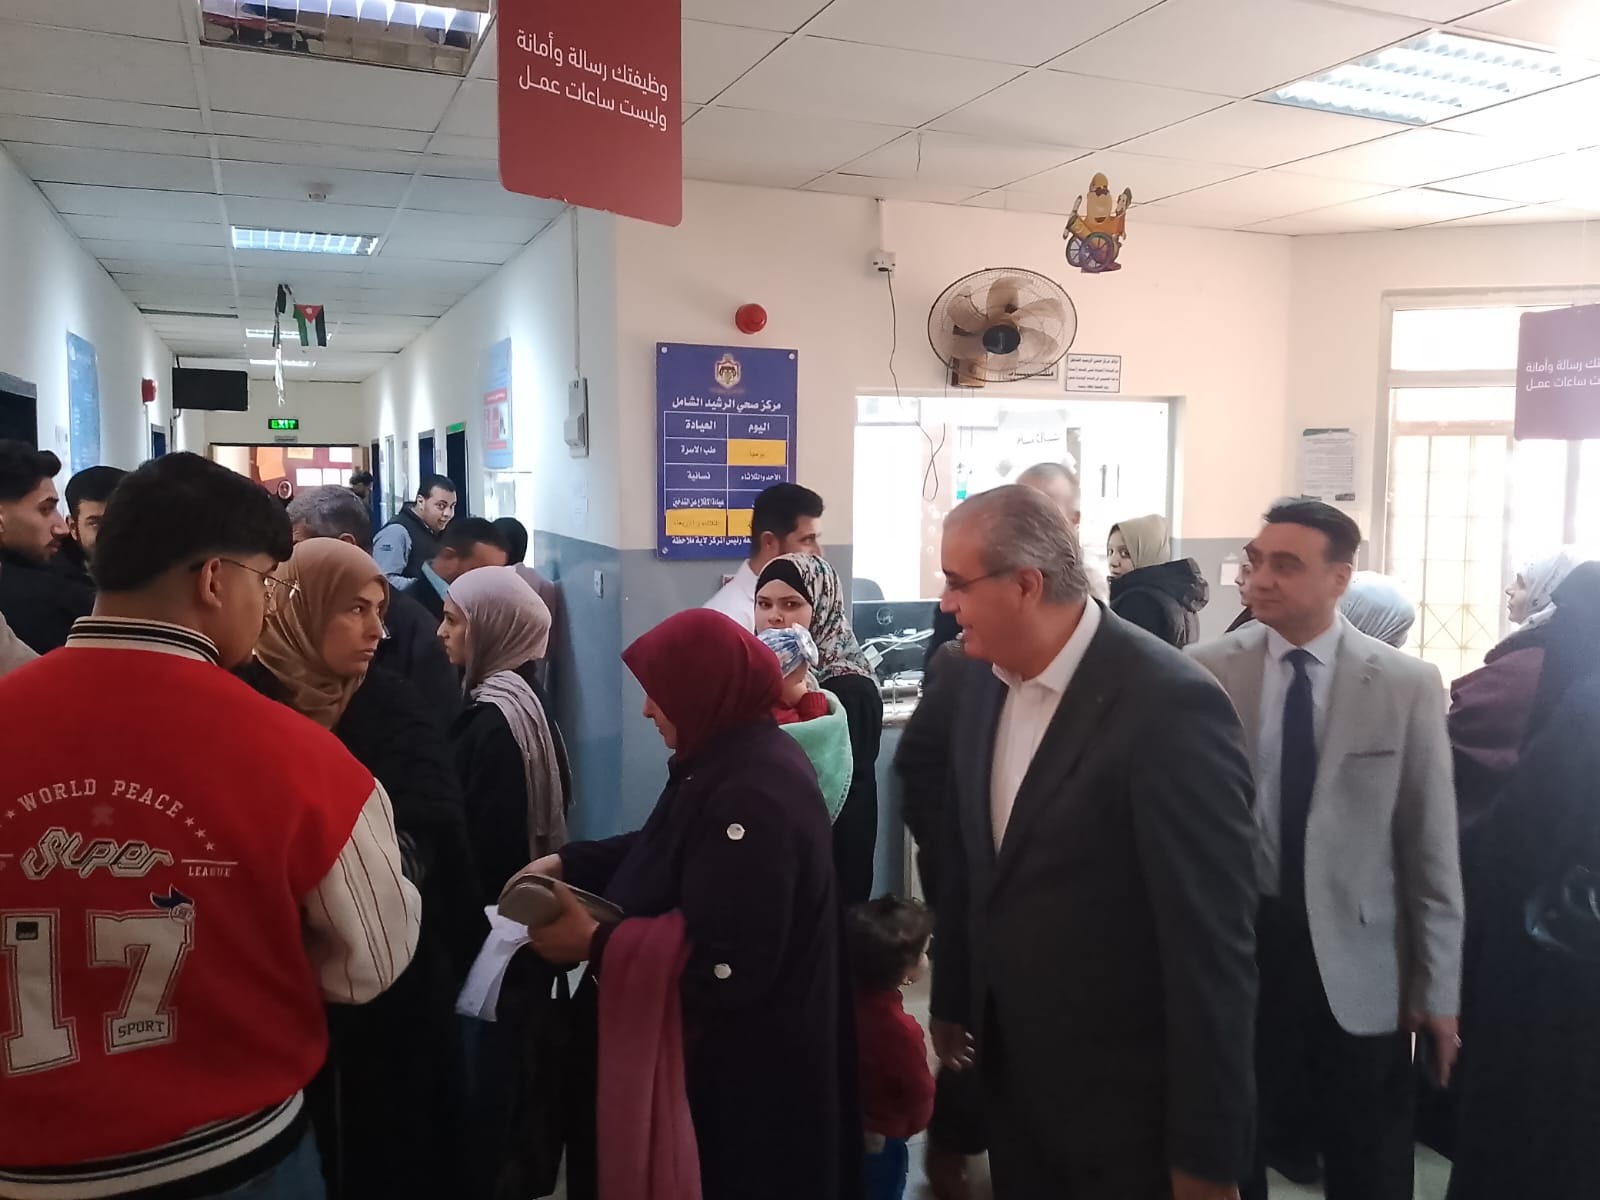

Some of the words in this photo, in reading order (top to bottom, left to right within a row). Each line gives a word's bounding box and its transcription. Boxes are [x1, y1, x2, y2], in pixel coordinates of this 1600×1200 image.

[516, 29, 563, 67] وأمانة
[568, 46, 608, 82] رسالة
[518, 64, 561, 95] عمل
[612, 64, 669, 102] وظيفتك
[565, 82, 615, 111] ساعات
[619, 99, 667, 132] وليست
[1526, 357, 1554, 374] وأمانة
[1556, 359, 1583, 373] رسالة
[1553, 375, 1587, 387] ساعات
[672, 395, 703, 408] الشامل
[704, 395, 735, 411] الرشيد
[736, 400, 759, 413] صحي
[760, 399, 781, 412] مركز
[271, 419, 296, 429] EXIT
[685, 419, 716, 432] العيادة
[748, 422, 770, 434] اليوم
[703, 445, 716, 456] طب
[17, 778, 97, 811] WORLD
[112, 779, 184, 818] PEACE
[1, 908, 195, 1077] 17
[118, 1019, 165, 1039] SPORT
